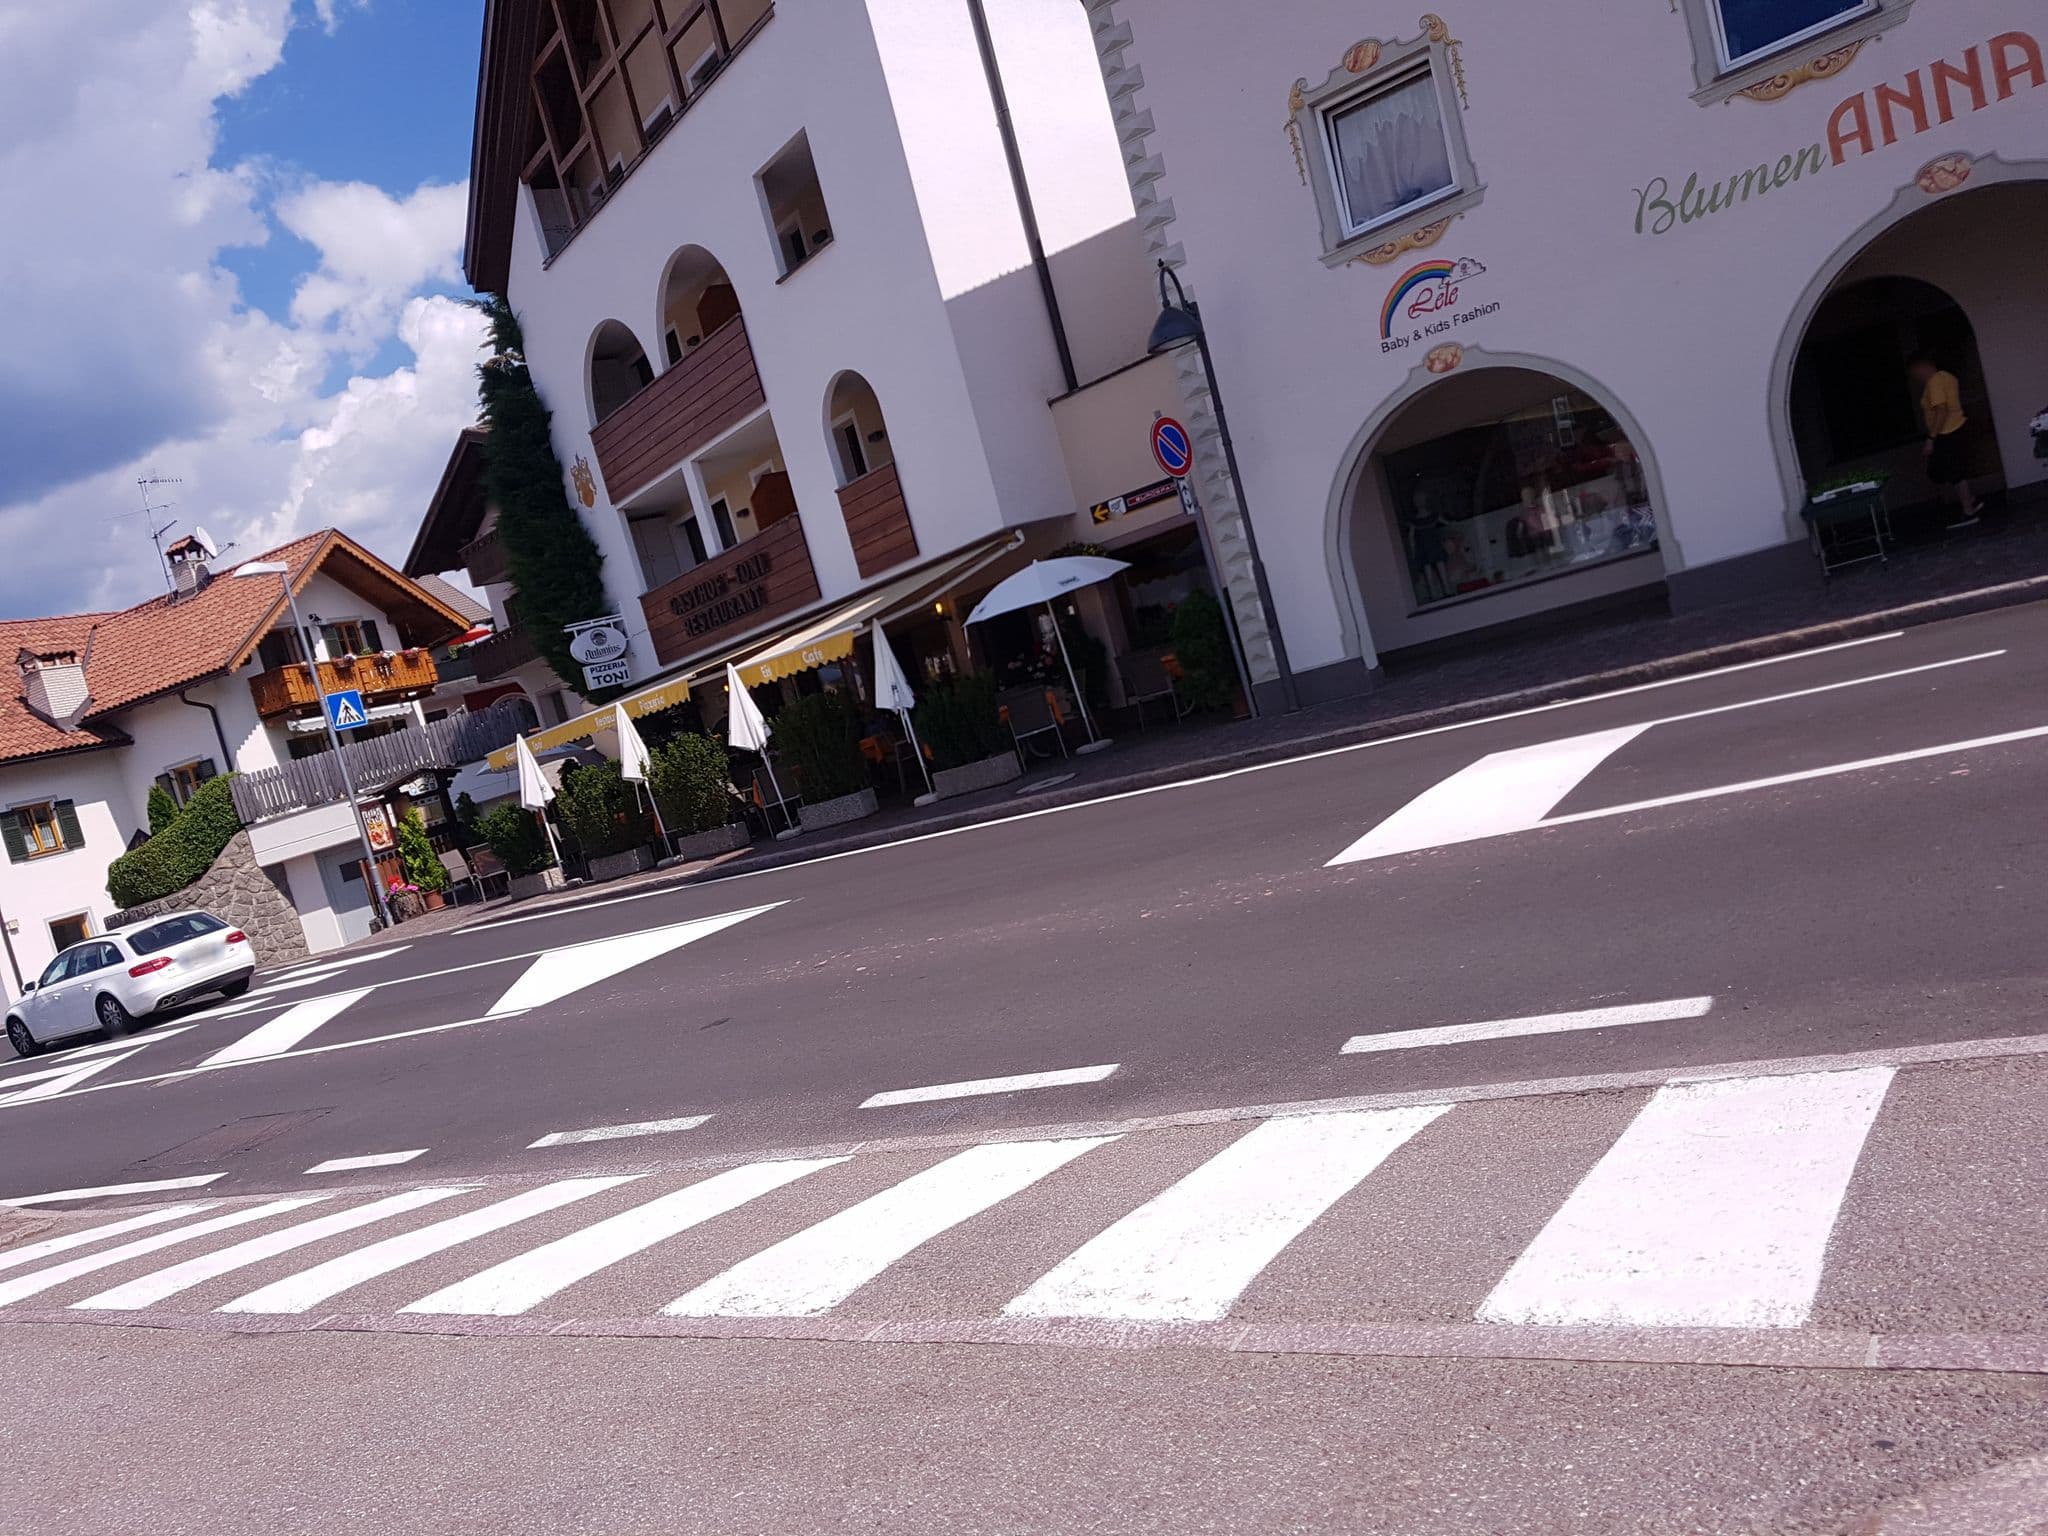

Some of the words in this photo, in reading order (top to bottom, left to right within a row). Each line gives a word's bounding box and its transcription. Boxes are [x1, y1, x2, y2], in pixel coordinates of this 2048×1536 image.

[1632, 142, 1826, 234] Blumen
[1826, 30, 2047, 166] ANNA
[1408, 281, 1459, 319] Lete
[1381, 335, 1410, 353] Baby
[1414, 330, 1421, 341] &
[1425, 320, 1450, 337] Kids
[1453, 302, 1500, 326] Fashion
[684, 583, 768, 637] RESTAURANT
[590, 661, 626, 674] PIZZERIA
[592, 670, 629, 685] TONI
